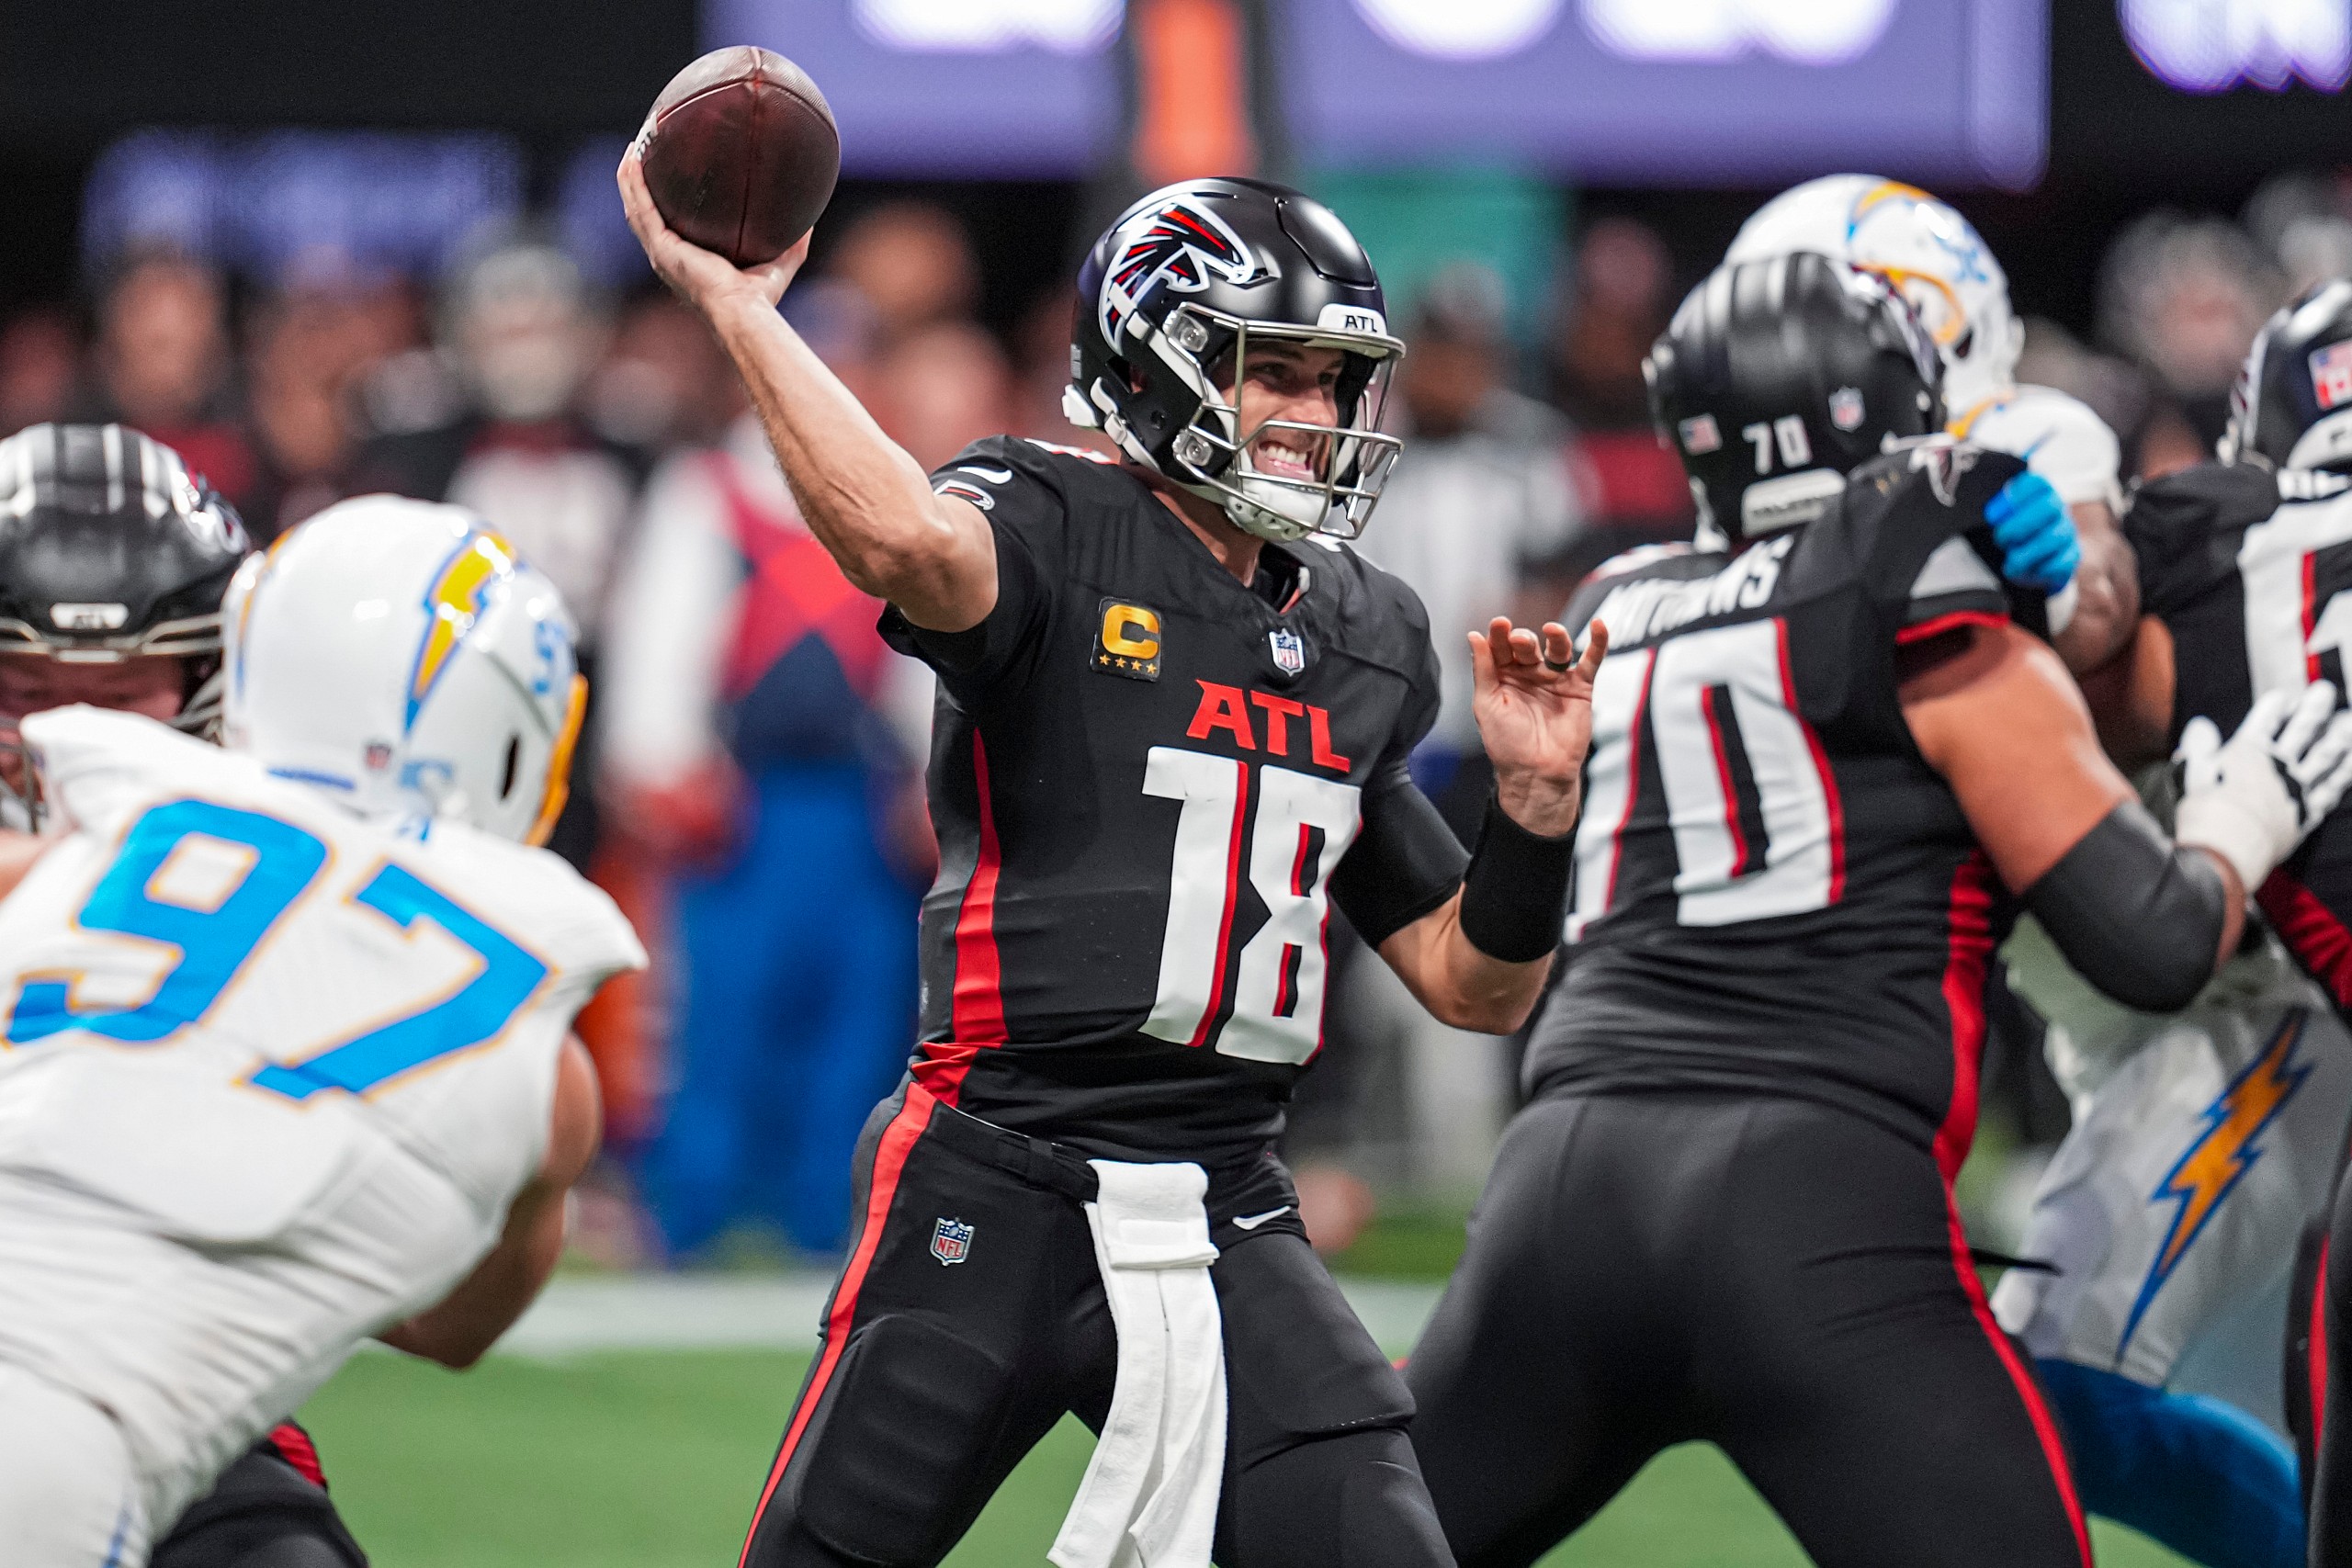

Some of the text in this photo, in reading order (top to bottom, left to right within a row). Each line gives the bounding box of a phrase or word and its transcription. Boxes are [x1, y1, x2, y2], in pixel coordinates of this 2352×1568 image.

[1345, 314, 1377, 333] ATL
[1741, 413, 1814, 476] 70
[1102, 604, 1159, 660] C
[1185, 678, 1351, 773] ATL
[1136, 745, 1363, 1066] 18
[1, 795, 562, 1110] 97
